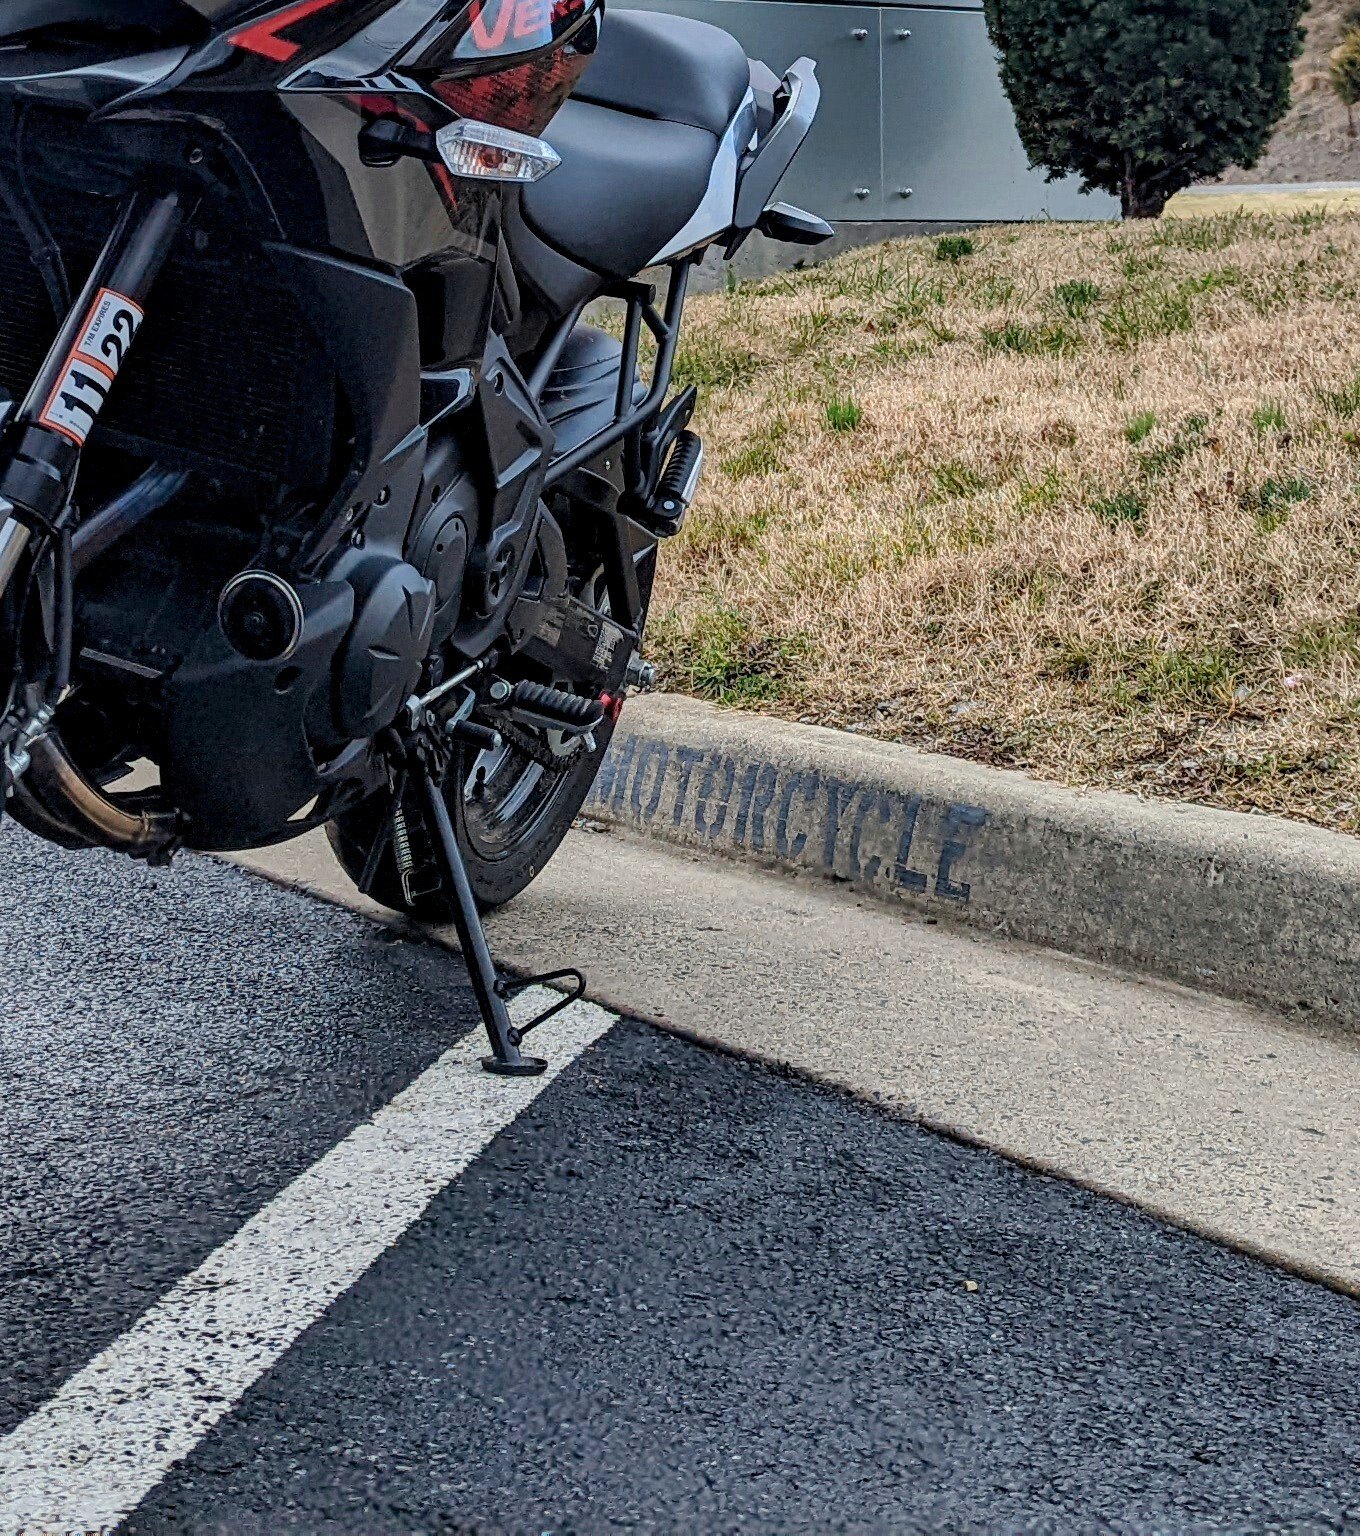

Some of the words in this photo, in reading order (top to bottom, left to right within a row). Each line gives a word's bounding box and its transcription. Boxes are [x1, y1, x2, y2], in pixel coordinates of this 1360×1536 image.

[91, 300, 111, 333] EXPIRES
[101, 308, 140, 368] 22
[60, 369, 107, 415] 11
[591, 734, 989, 902] MOTORCYCLE
